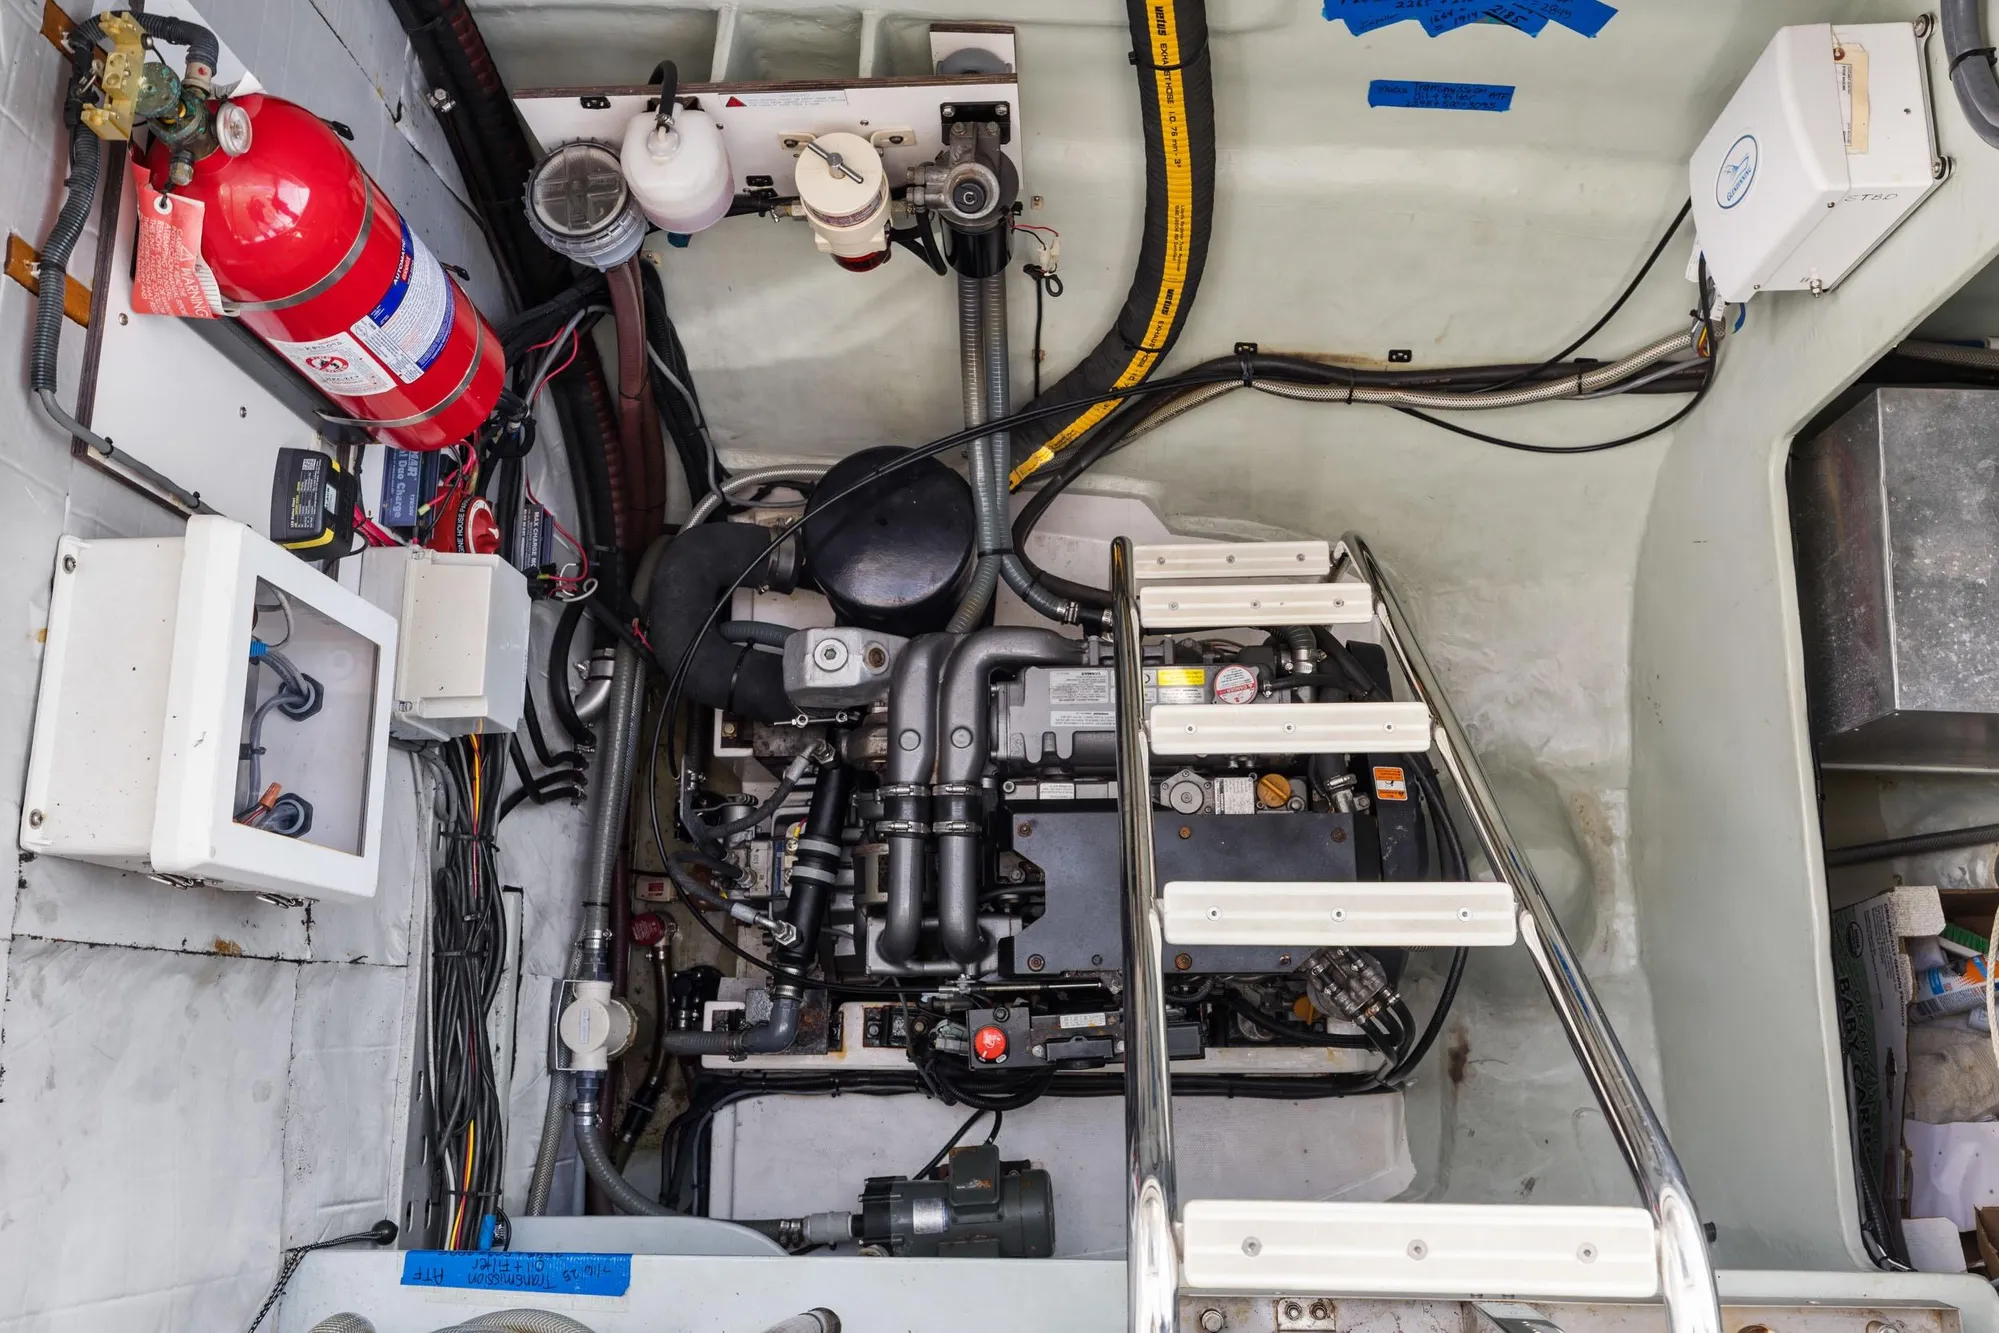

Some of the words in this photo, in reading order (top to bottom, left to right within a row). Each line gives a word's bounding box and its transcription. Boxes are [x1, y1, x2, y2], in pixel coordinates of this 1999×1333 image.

[1154, 6, 1168, 36] vetus
[1454, 11, 1478, 27] 1914
[1489, 4, 1528, 23] 2185
[1160, 43, 1172, 81] EXHAST
[1165, 82, 1174, 104] HOSE
[1172, 139, 1178, 152] mm
[393, 238, 406, 285] AUTOMATIC
[181, 268, 209, 317] WARNING
[1162, 289, 1174, 315] vetus
[397, 460, 407, 479] Duo
[393, 482, 405, 518] Charge
[457, 538, 465, 553] GINE
[1884, 903, 1896, 957] ORGANICALLY
[1893, 958, 1902, 990] GROWN
[1838, 977, 1859, 1056] BABY
[471, 1258, 509, 1272] Filter
[526, 1259, 544, 1272] Oil
[412, 1268, 443, 1284] ATF
[467, 1273, 556, 1289] Transmission
